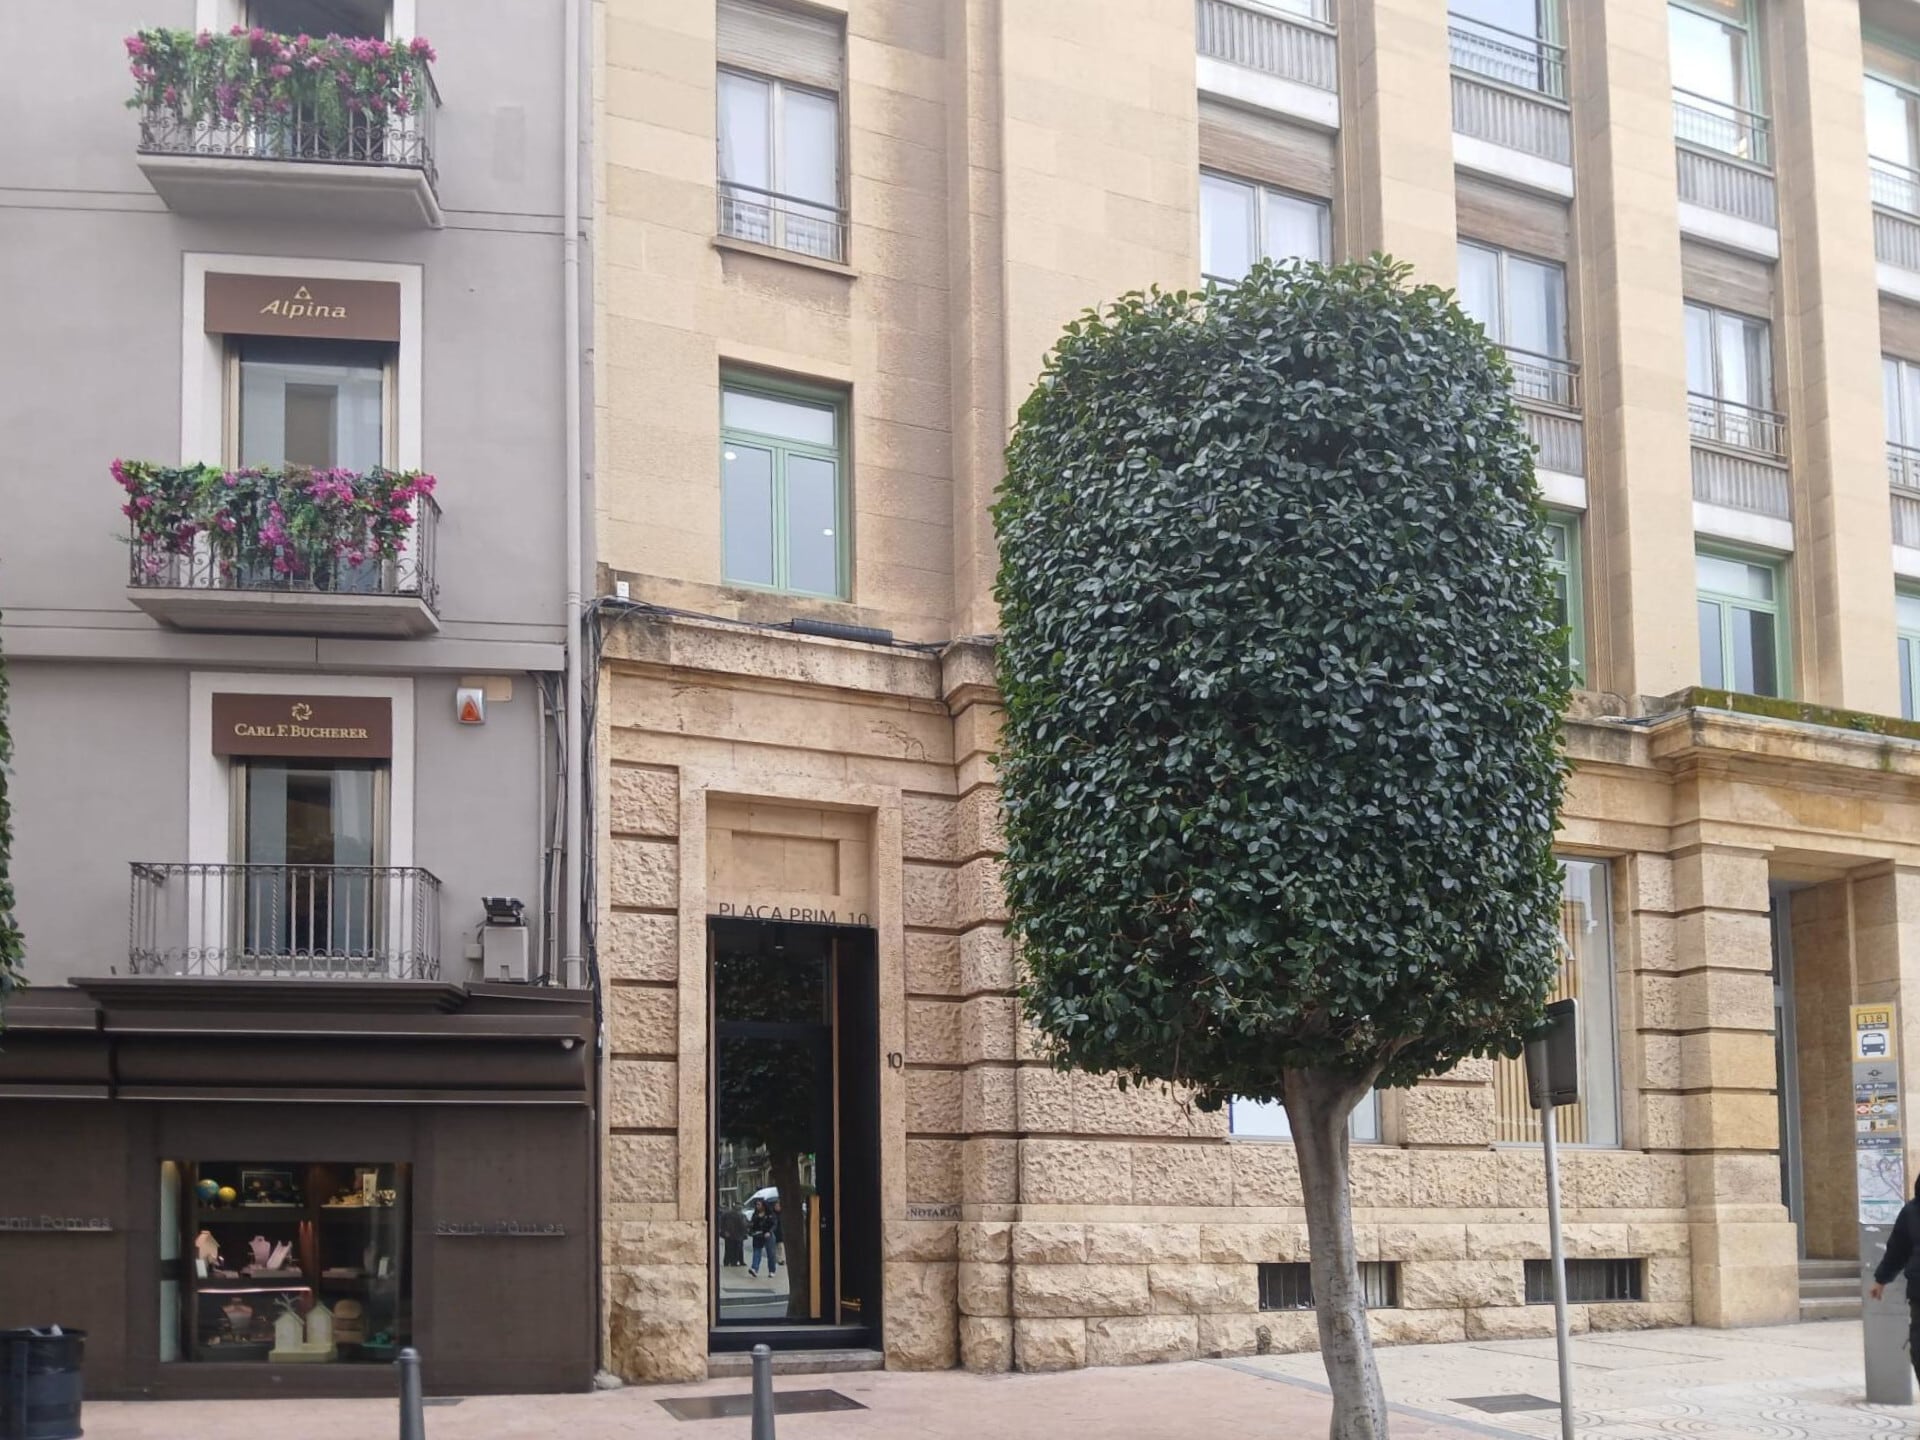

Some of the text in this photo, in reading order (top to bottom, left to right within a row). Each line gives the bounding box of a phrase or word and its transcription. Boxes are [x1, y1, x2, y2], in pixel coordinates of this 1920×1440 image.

[260, 300, 347, 319] Alpina
[234, 723, 275, 737] CARL
[290, 725, 369, 739] BUCHERER
[790, 907, 837, 924] PRIM
[848, 912, 871, 927] 10
[1863, 1014, 1883, 1024] 118
[886, 1051, 903, 1069] 10
